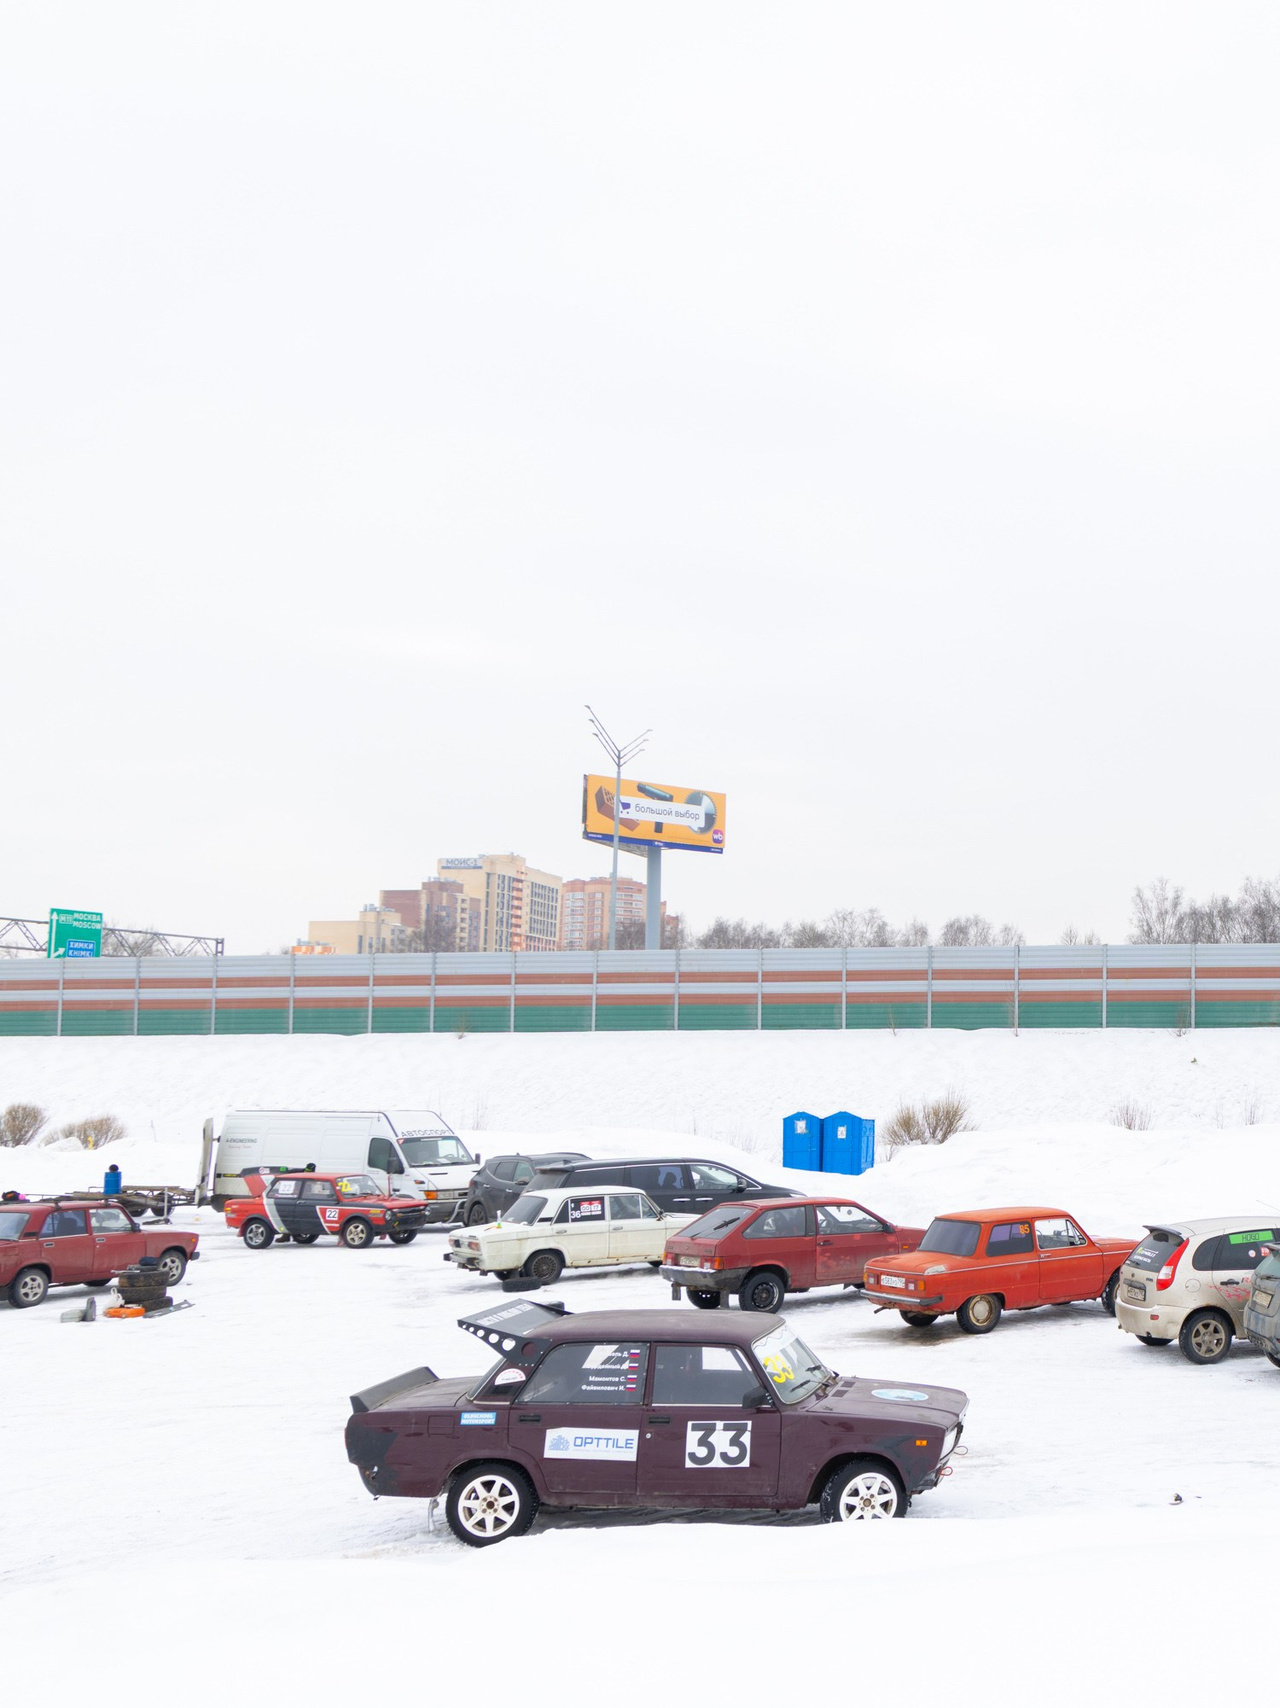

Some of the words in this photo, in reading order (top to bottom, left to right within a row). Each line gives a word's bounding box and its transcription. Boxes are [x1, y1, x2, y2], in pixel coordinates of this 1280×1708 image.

[634, 803, 673, 817] большой
[675, 809, 700, 821] выбор
[712, 831, 724, 842] wb
[73, 912, 101, 921] МОСКВА
[72, 920, 101, 929] MOSCOW
[69, 941, 94, 949] ХИМКИ
[401, 1129, 450, 1137] АВТОСПОРТ
[327, 1209, 338, 1219] 22
[570, 1210, 581, 1219] 36
[1018, 1224, 1030, 1235] 85
[763, 1355, 795, 1384] 33
[573, 1436, 635, 1449] OPTTILE
[687, 1422, 749, 1466] 33
